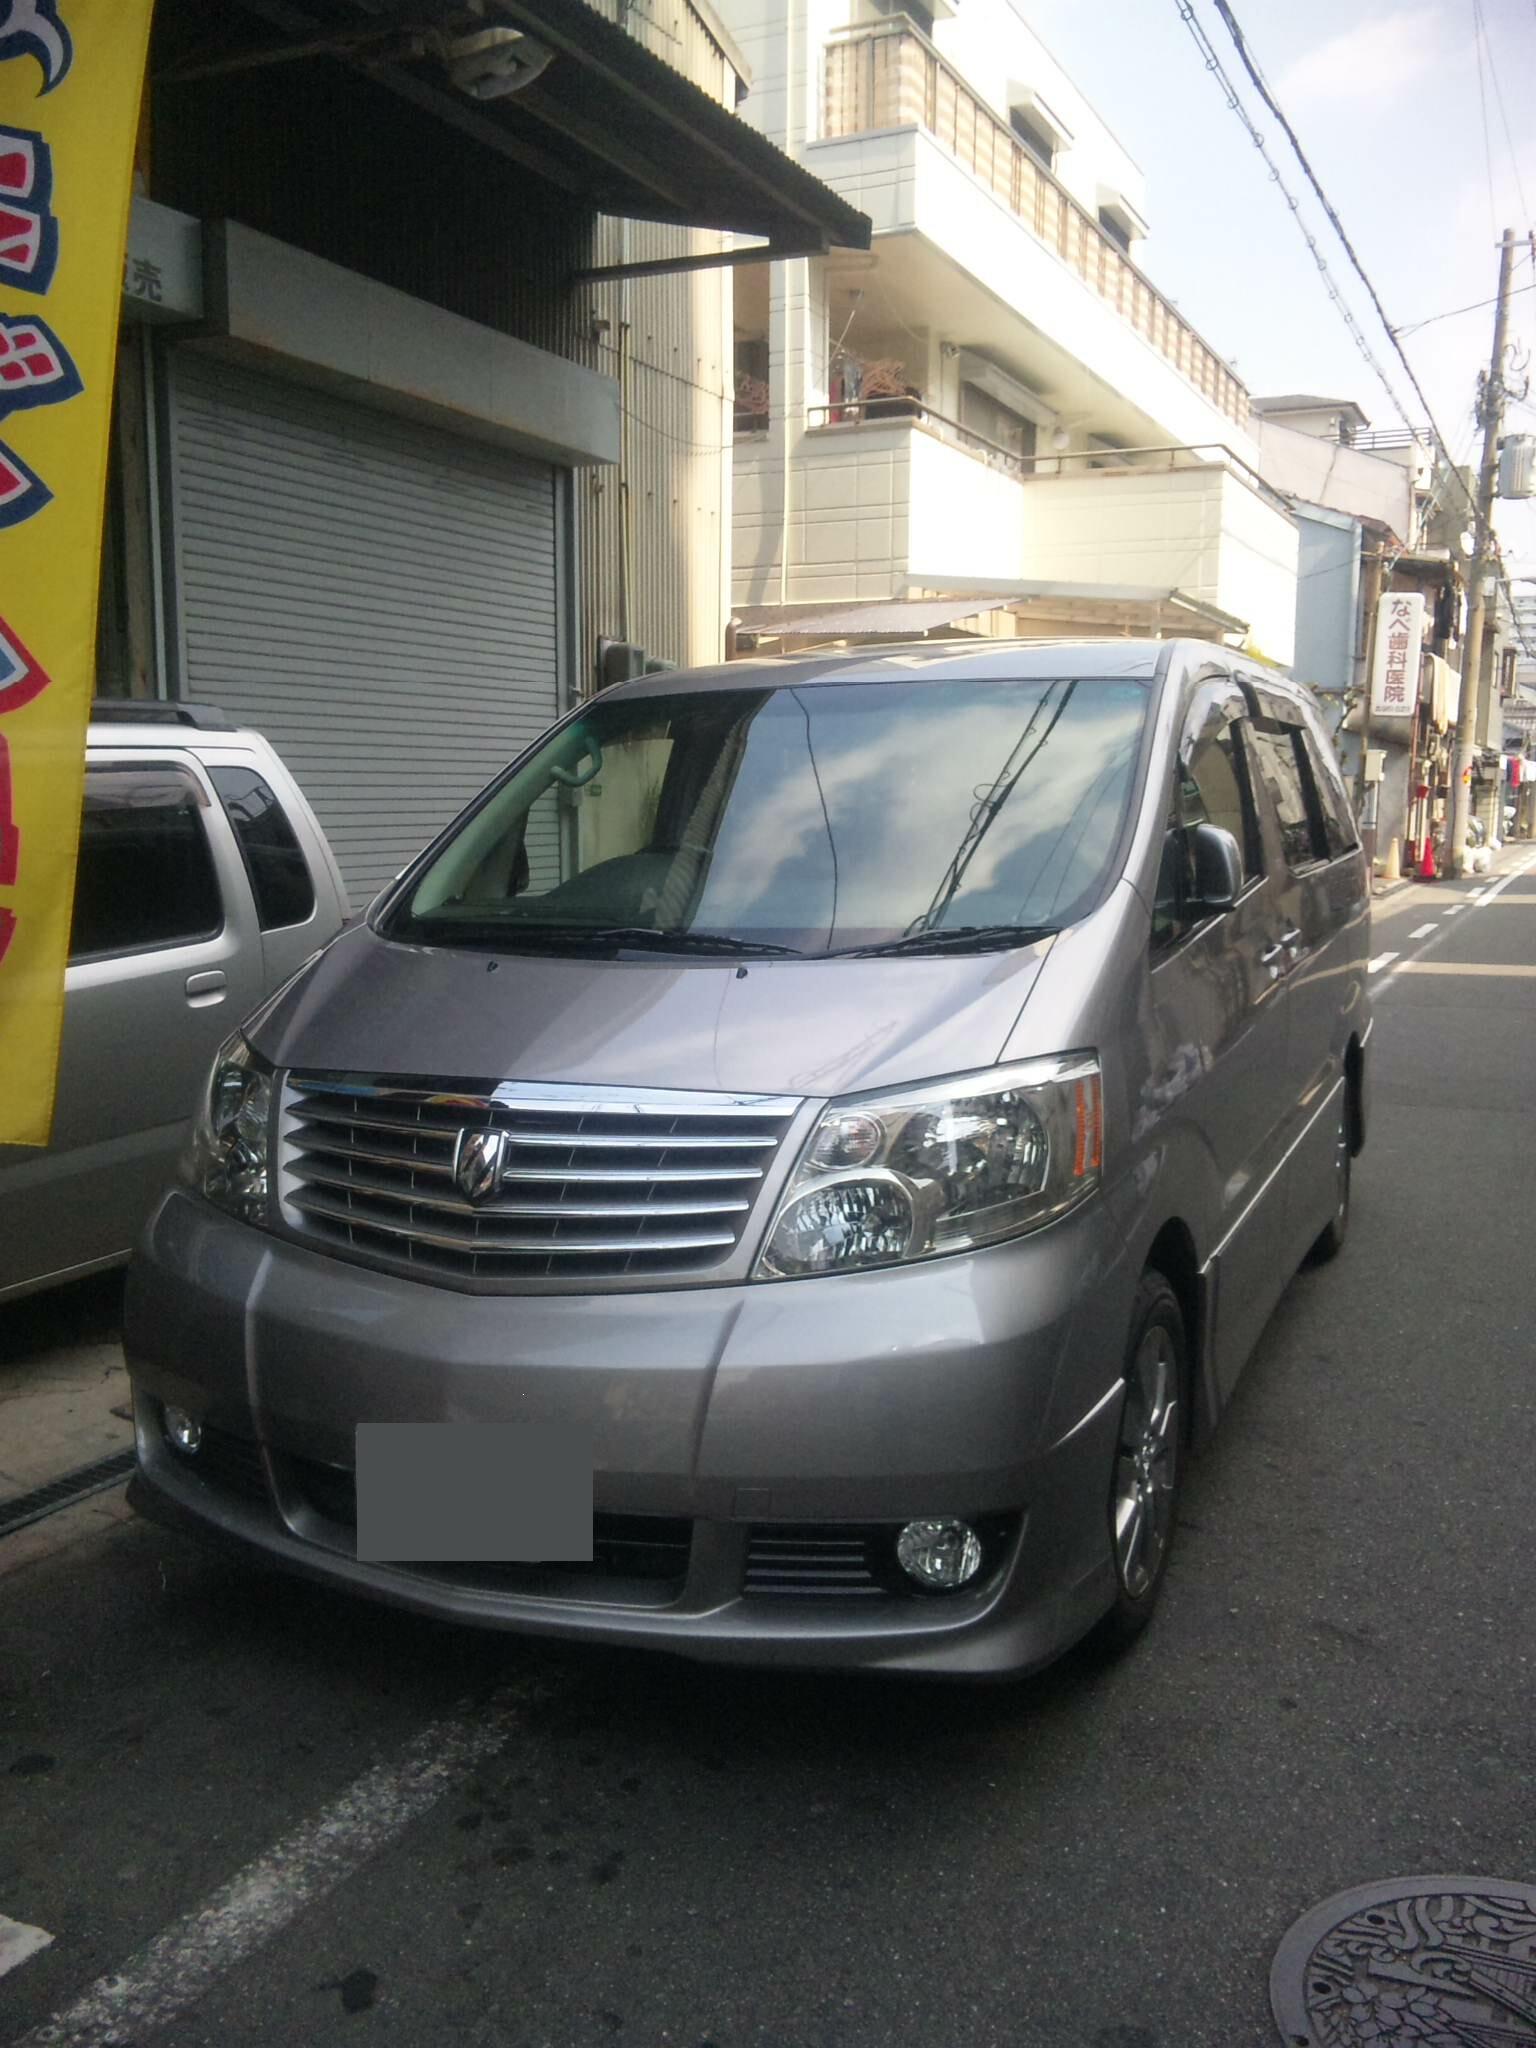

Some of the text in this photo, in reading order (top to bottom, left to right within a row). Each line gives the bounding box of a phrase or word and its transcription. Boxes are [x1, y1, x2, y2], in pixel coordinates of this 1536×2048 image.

[124, 258, 162, 302] 売
[1384, 599, 1412, 703] なべ歯科医院
